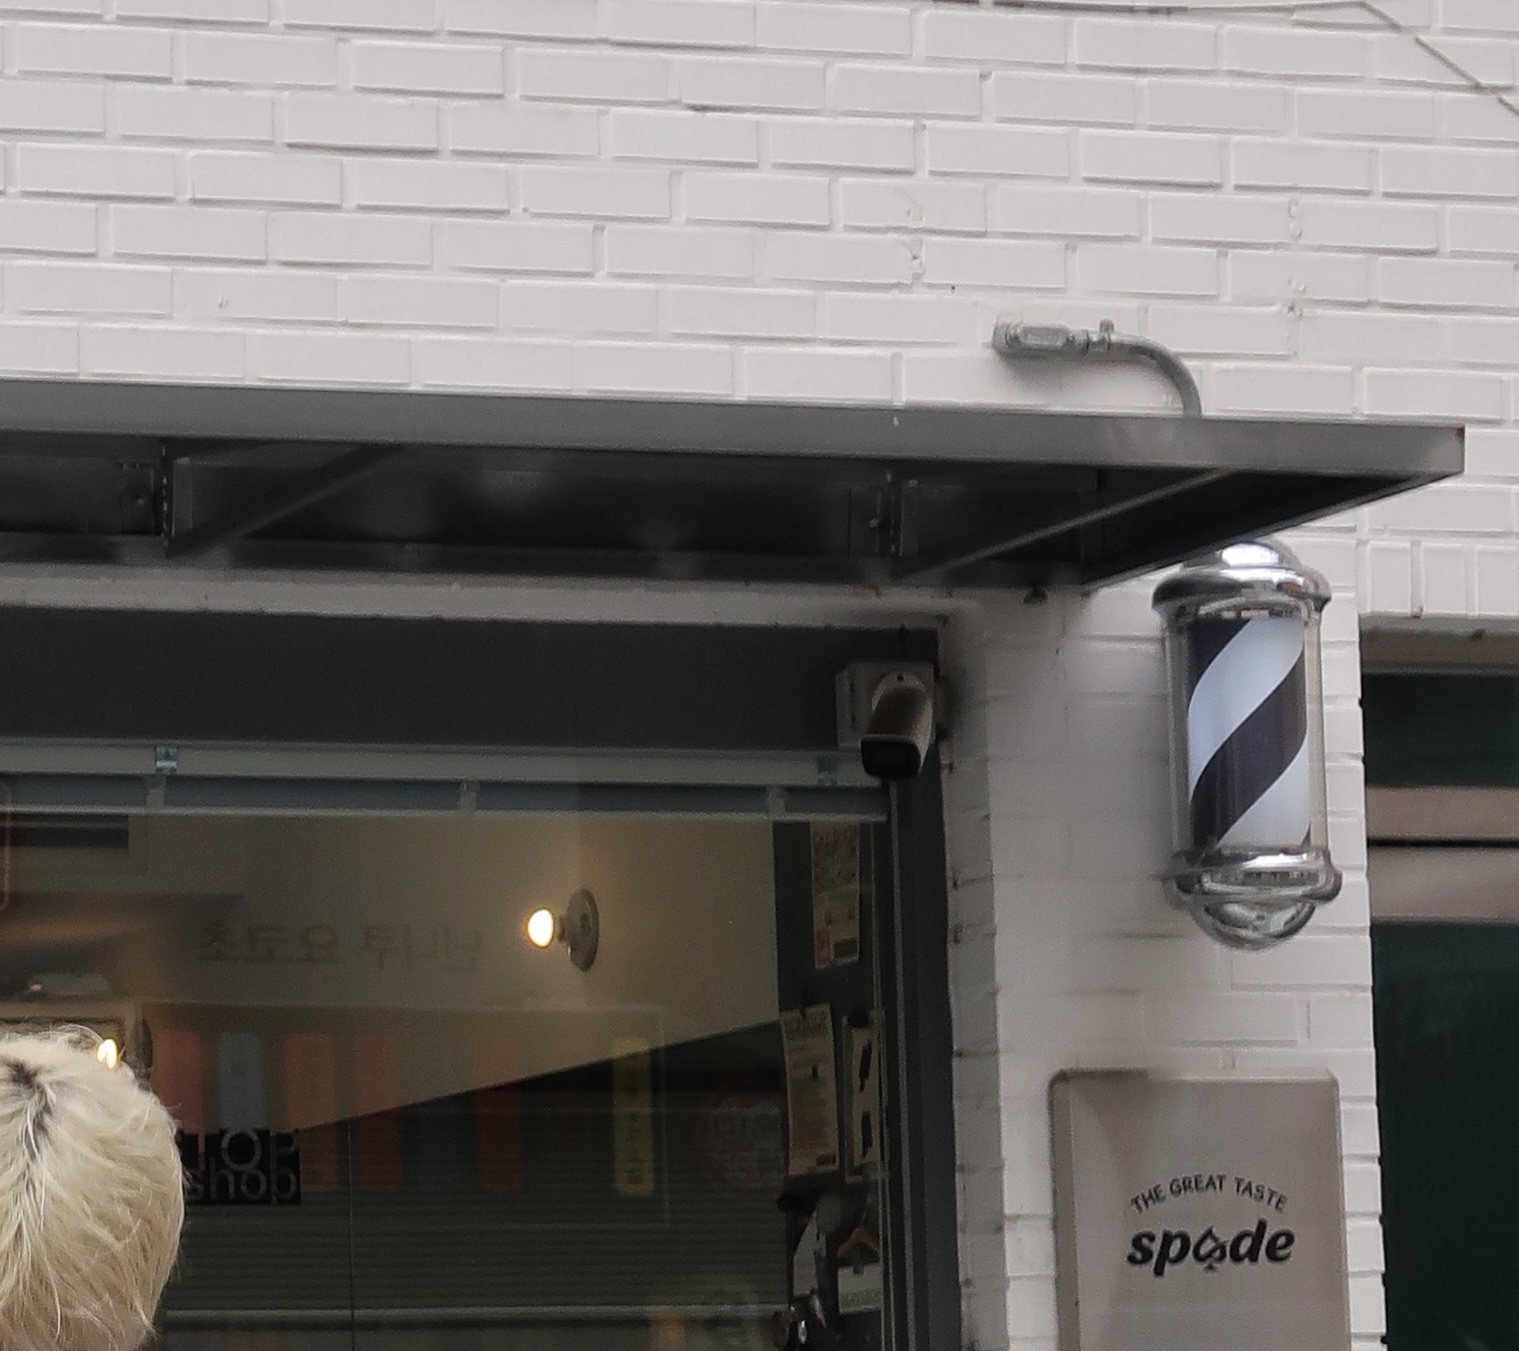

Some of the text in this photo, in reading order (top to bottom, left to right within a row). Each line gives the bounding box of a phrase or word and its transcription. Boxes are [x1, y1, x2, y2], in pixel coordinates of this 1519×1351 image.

[1130, 1173, 1290, 1214] THE GREAT TASTE
